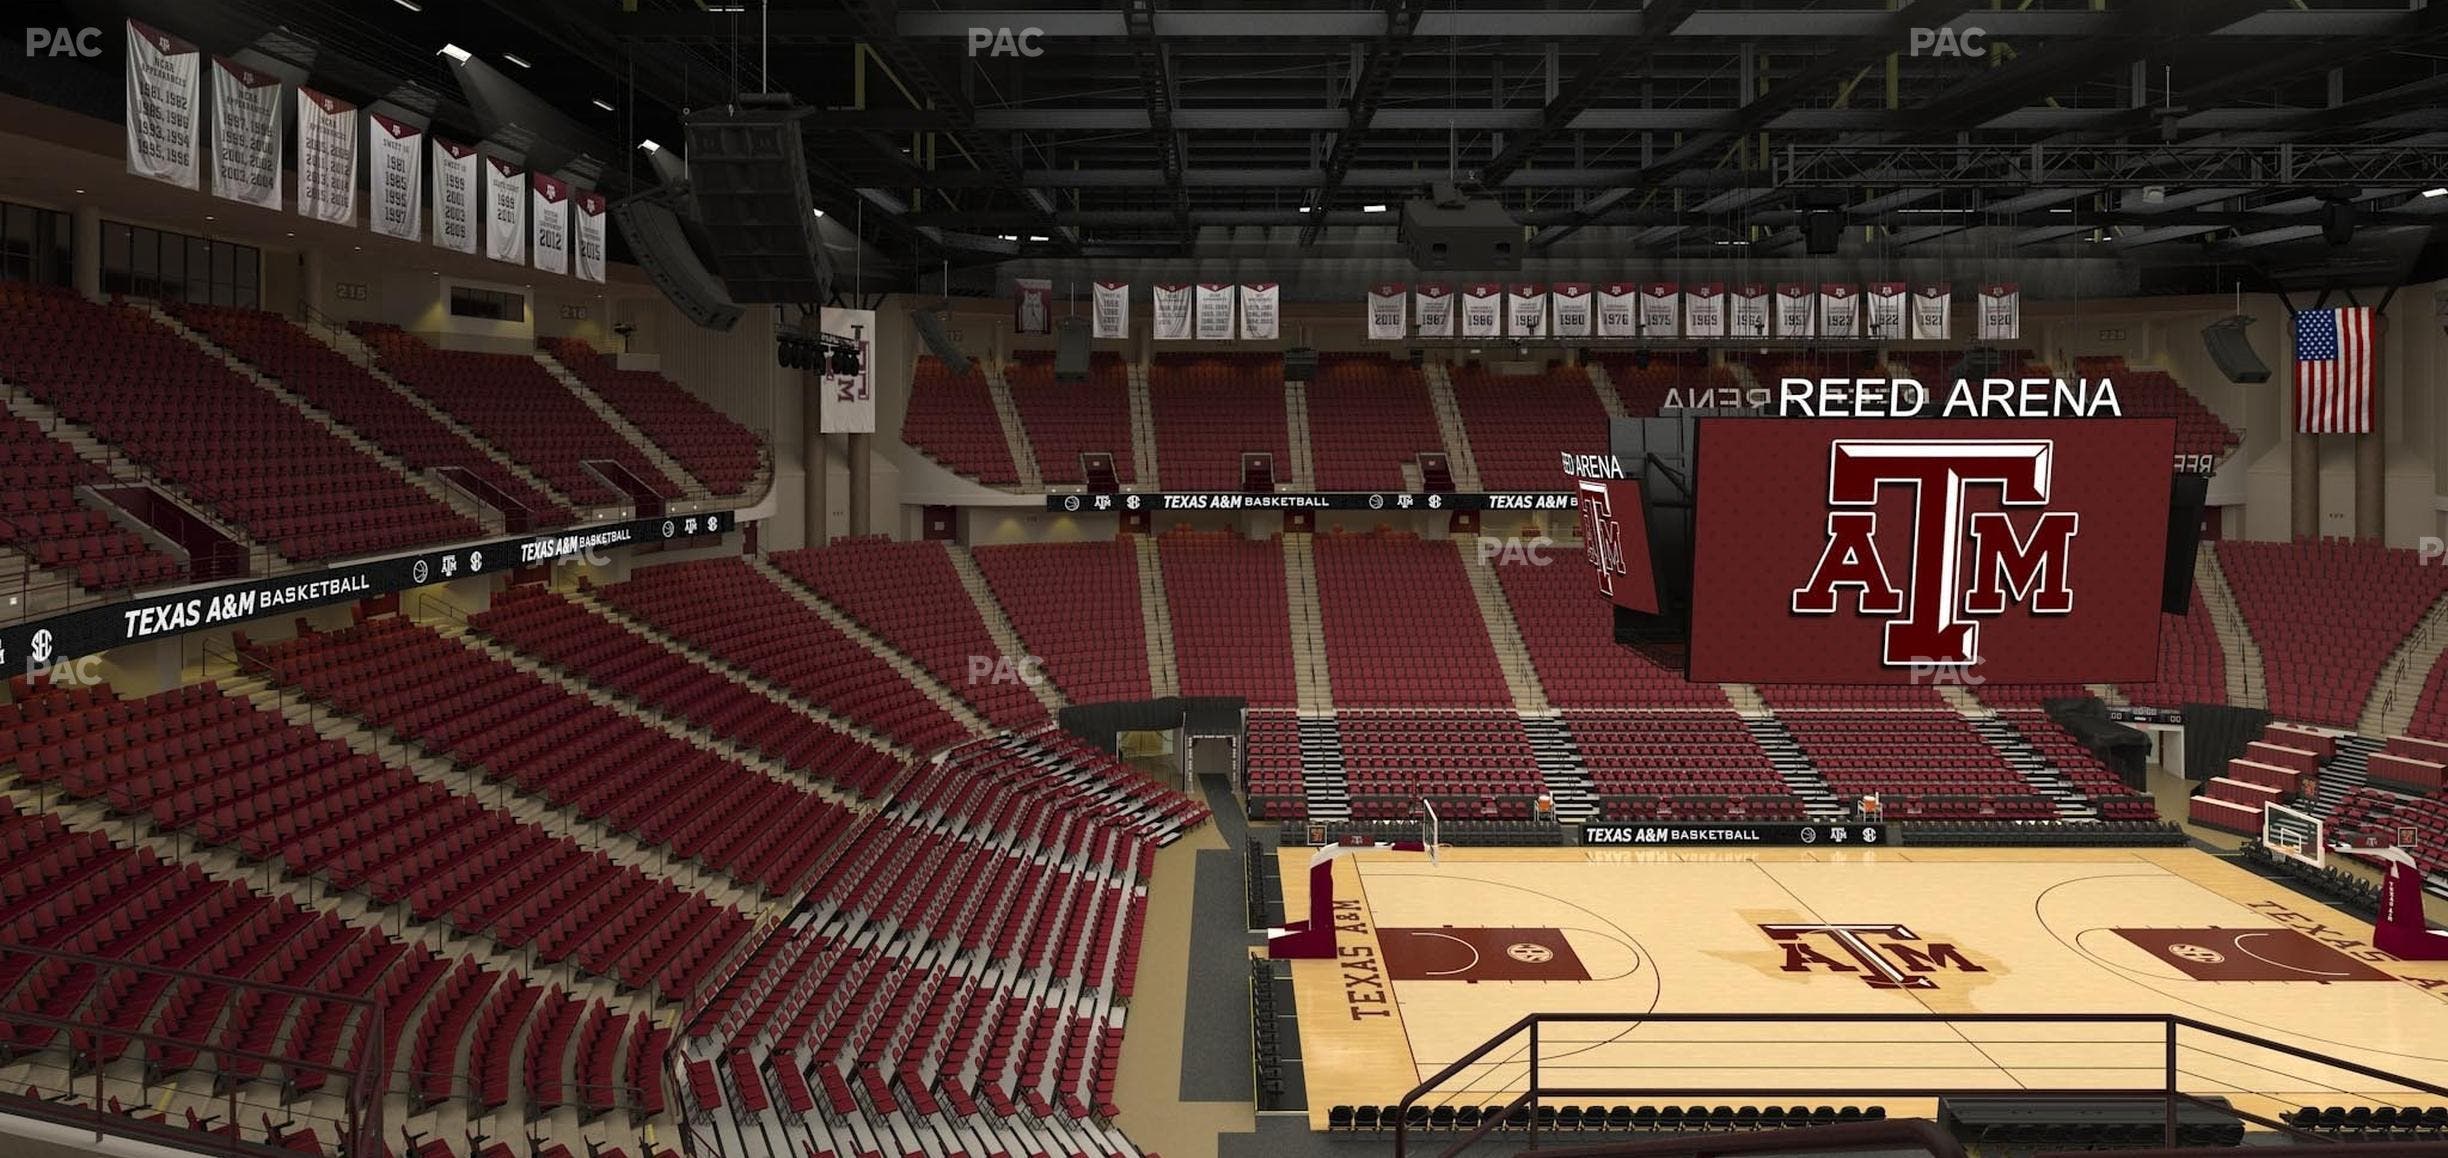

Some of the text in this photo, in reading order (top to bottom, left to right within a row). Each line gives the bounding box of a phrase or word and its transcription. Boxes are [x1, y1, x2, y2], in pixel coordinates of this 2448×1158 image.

[540, 229, 562, 251] 2012
[1421, 314, 1447, 326] 1987
[1779, 378, 2122, 417] REED ARENA
[1576, 454, 1625, 479] ARENA
[1164, 495, 1329, 508] TEXAS A&M BASKETBALL
[1489, 496, 1532, 508] TEXAS
[1535, 496, 1567, 508] A&M
[521, 529, 632, 562] TEXAS A&M BASKETBALL
[125, 574, 370, 638] TEXAS A&M BASKETBALL
[1586, 828, 1760, 842] TEXAS A&M BASKETBALL
[2248, 901, 2401, 961] TEXAS
[1332, 899, 1391, 1021] TEXAS A&M
